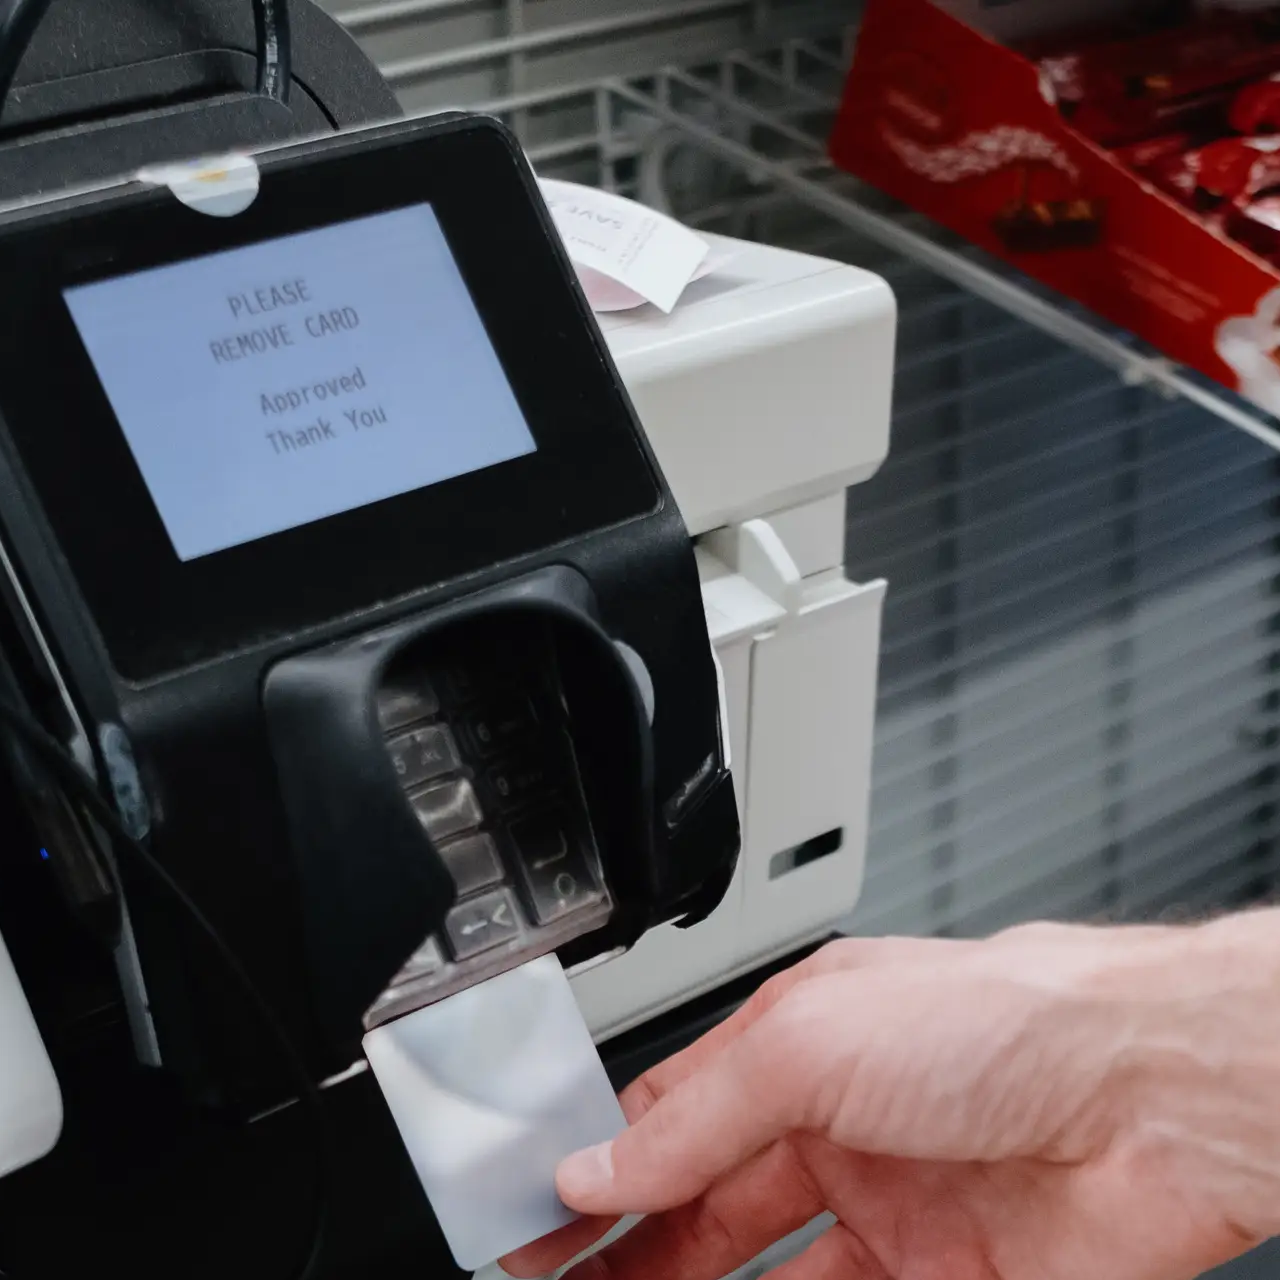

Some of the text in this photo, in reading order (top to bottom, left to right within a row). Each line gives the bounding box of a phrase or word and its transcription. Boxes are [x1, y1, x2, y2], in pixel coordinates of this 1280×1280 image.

[227, 278, 311, 319] PLEASE
[209, 306, 360, 364] REMOVE CARD
[260, 366, 366, 416] Approved
[265, 405, 388, 454] Thank You
[393, 756, 406, 774] 5
